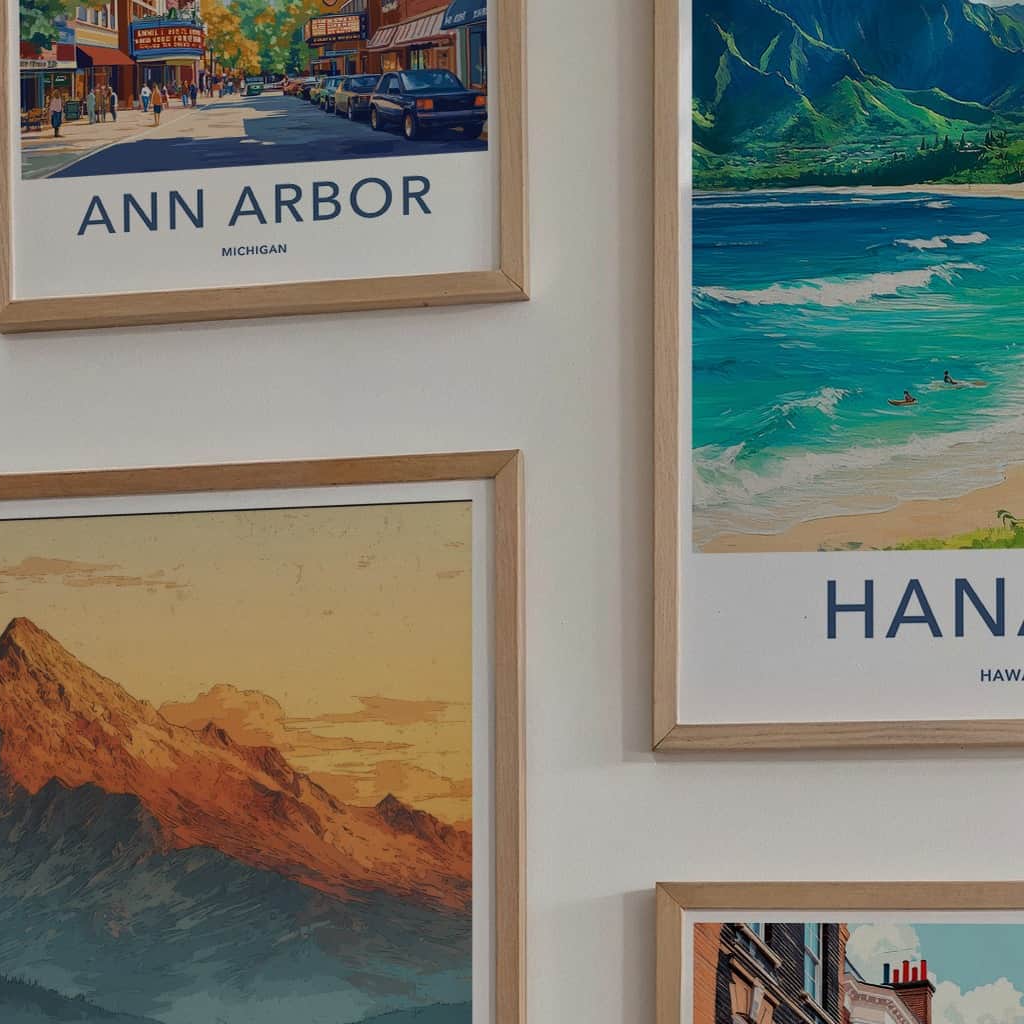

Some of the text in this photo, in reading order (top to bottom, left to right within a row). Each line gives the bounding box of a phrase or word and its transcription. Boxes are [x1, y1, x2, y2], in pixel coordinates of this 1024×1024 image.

[77, 175, 432, 236] ANN ARBOR
[221, 243, 288, 257] MICHIGAN
[826, 577, 1024, 640] HAN
[980, 668, 1024, 682] HAW
